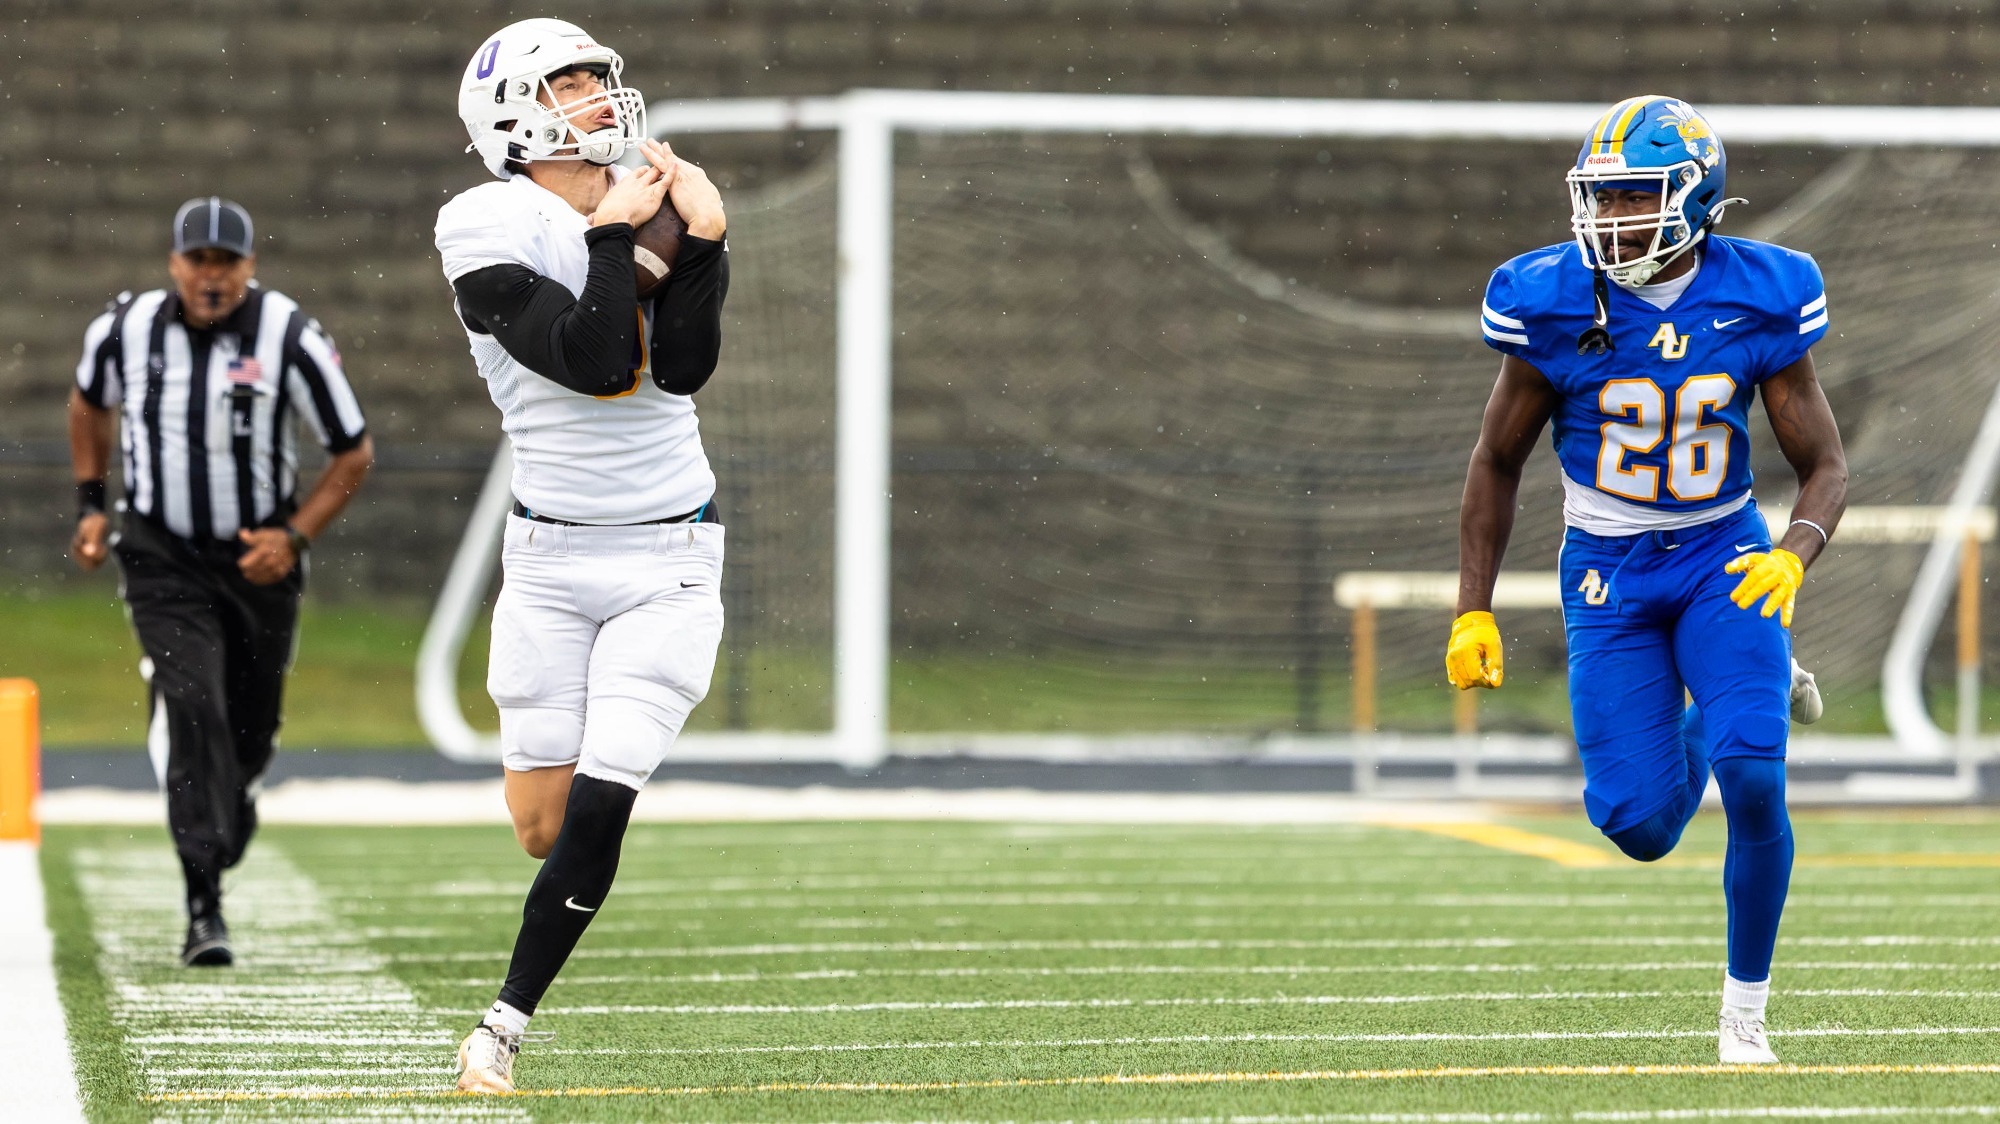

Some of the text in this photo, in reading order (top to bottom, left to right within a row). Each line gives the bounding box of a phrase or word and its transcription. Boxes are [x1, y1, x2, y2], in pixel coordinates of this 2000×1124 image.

[1587, 156, 1619, 165] Riddell
[1647, 322, 1691, 361] AU
[1596, 373, 1737, 502] 26
[1577, 568, 1609, 606] AU
